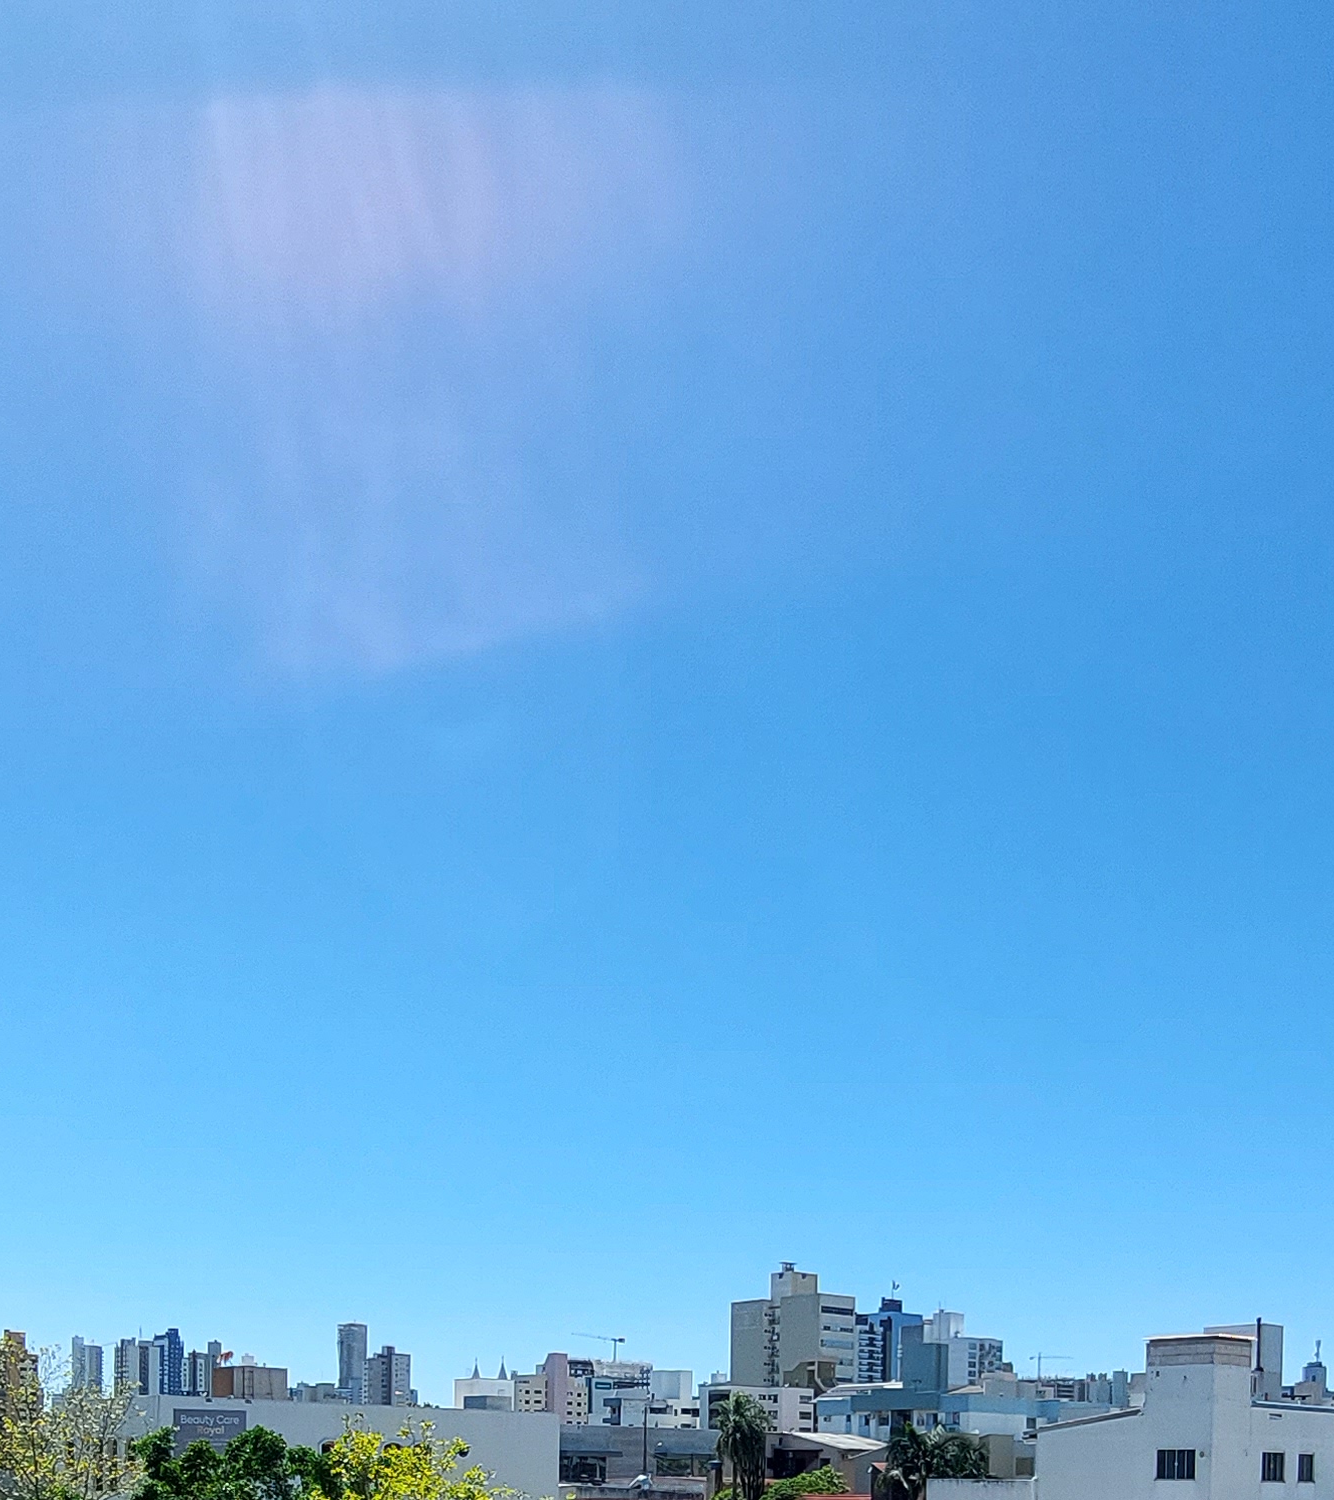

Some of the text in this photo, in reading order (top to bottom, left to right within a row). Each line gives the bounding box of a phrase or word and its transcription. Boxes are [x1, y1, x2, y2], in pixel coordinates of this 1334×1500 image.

[180, 1414, 240, 1426] Beauty Care
[196, 1425, 225, 1437] Royal
